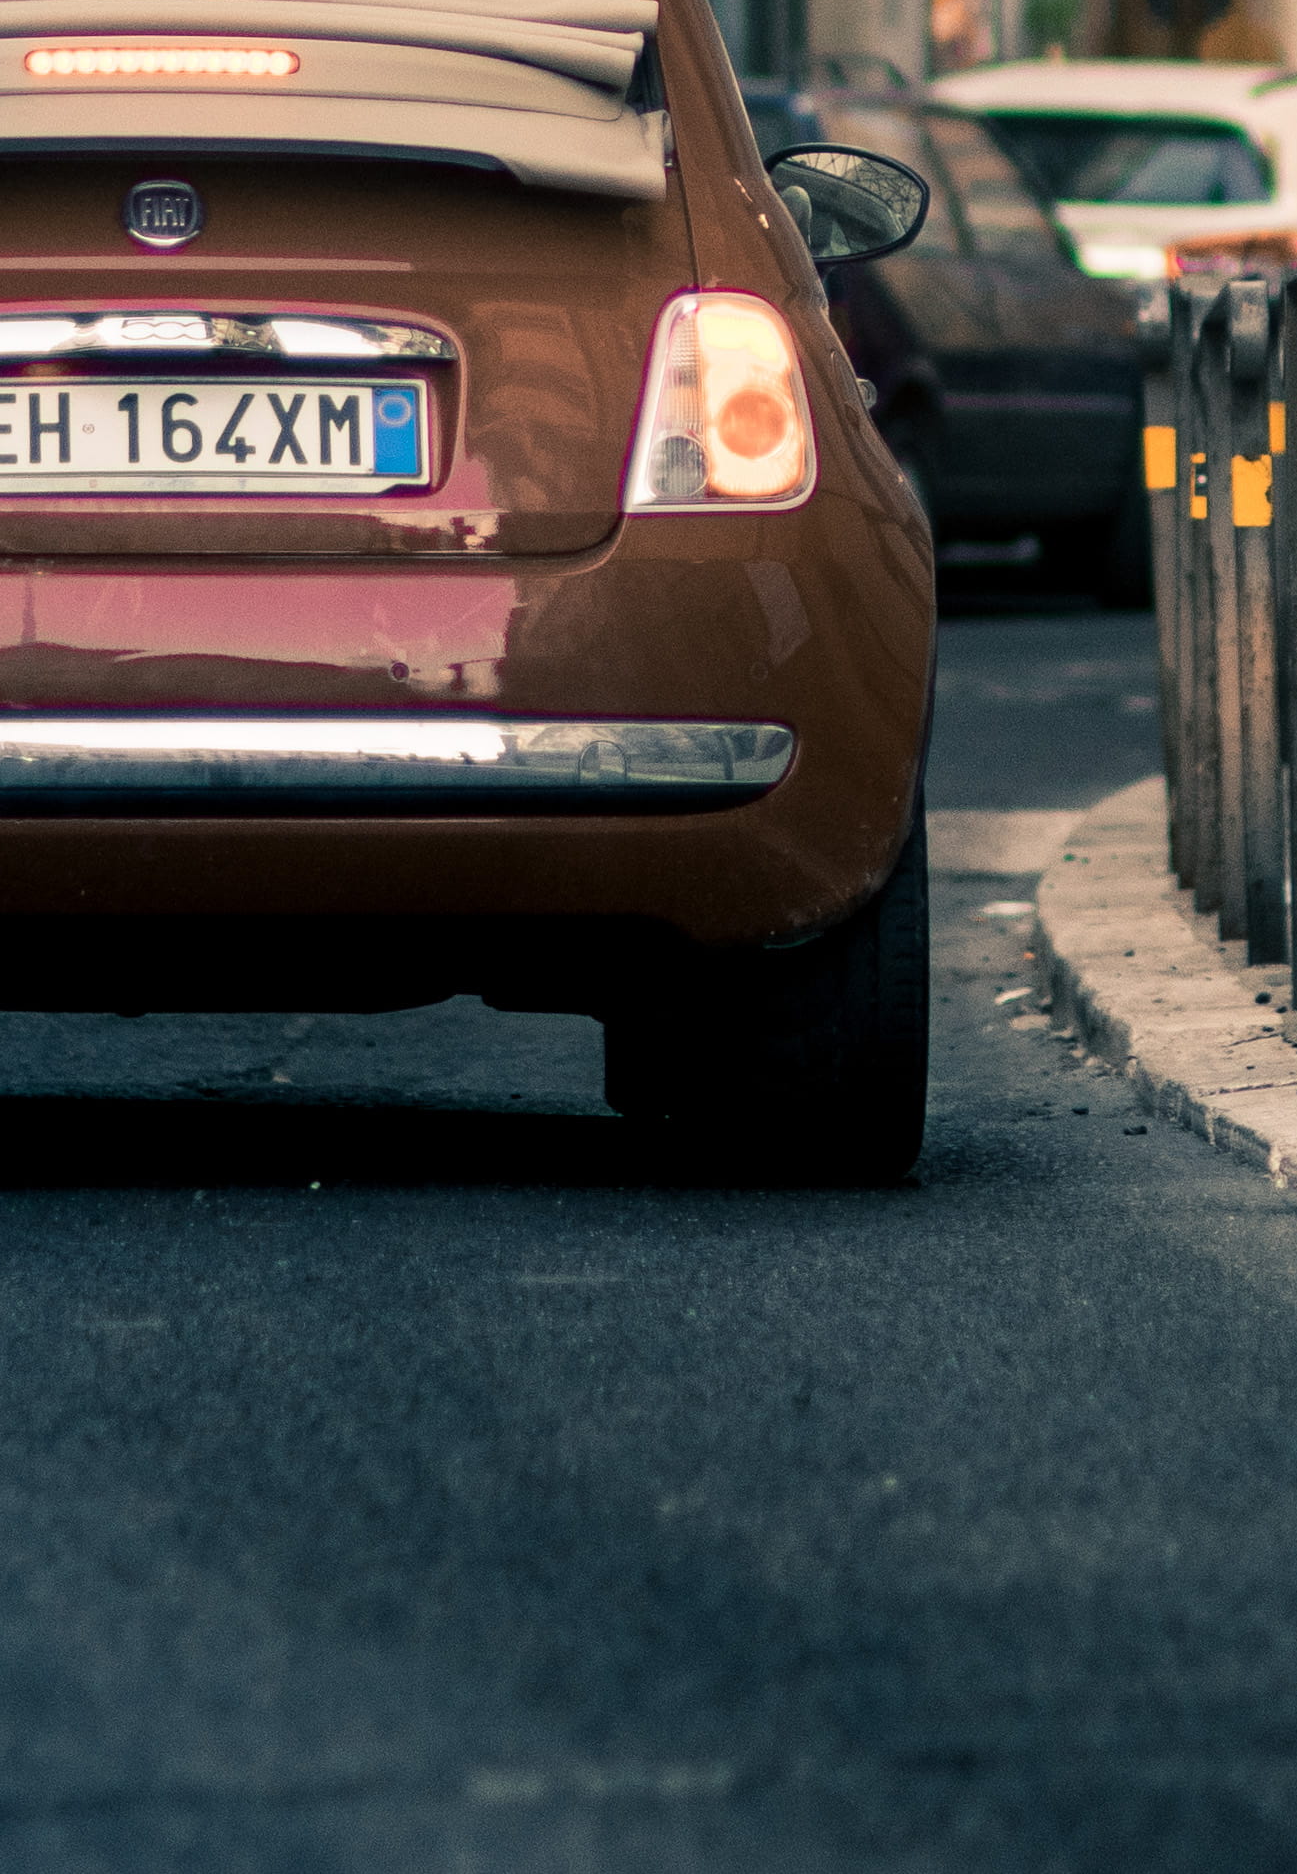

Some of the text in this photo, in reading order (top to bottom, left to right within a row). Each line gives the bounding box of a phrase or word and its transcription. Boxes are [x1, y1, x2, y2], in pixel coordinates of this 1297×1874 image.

[141, 197, 190, 227] FIAT
[121, 318, 217, 341] 500
[117, 392, 362, 466] 164XM
